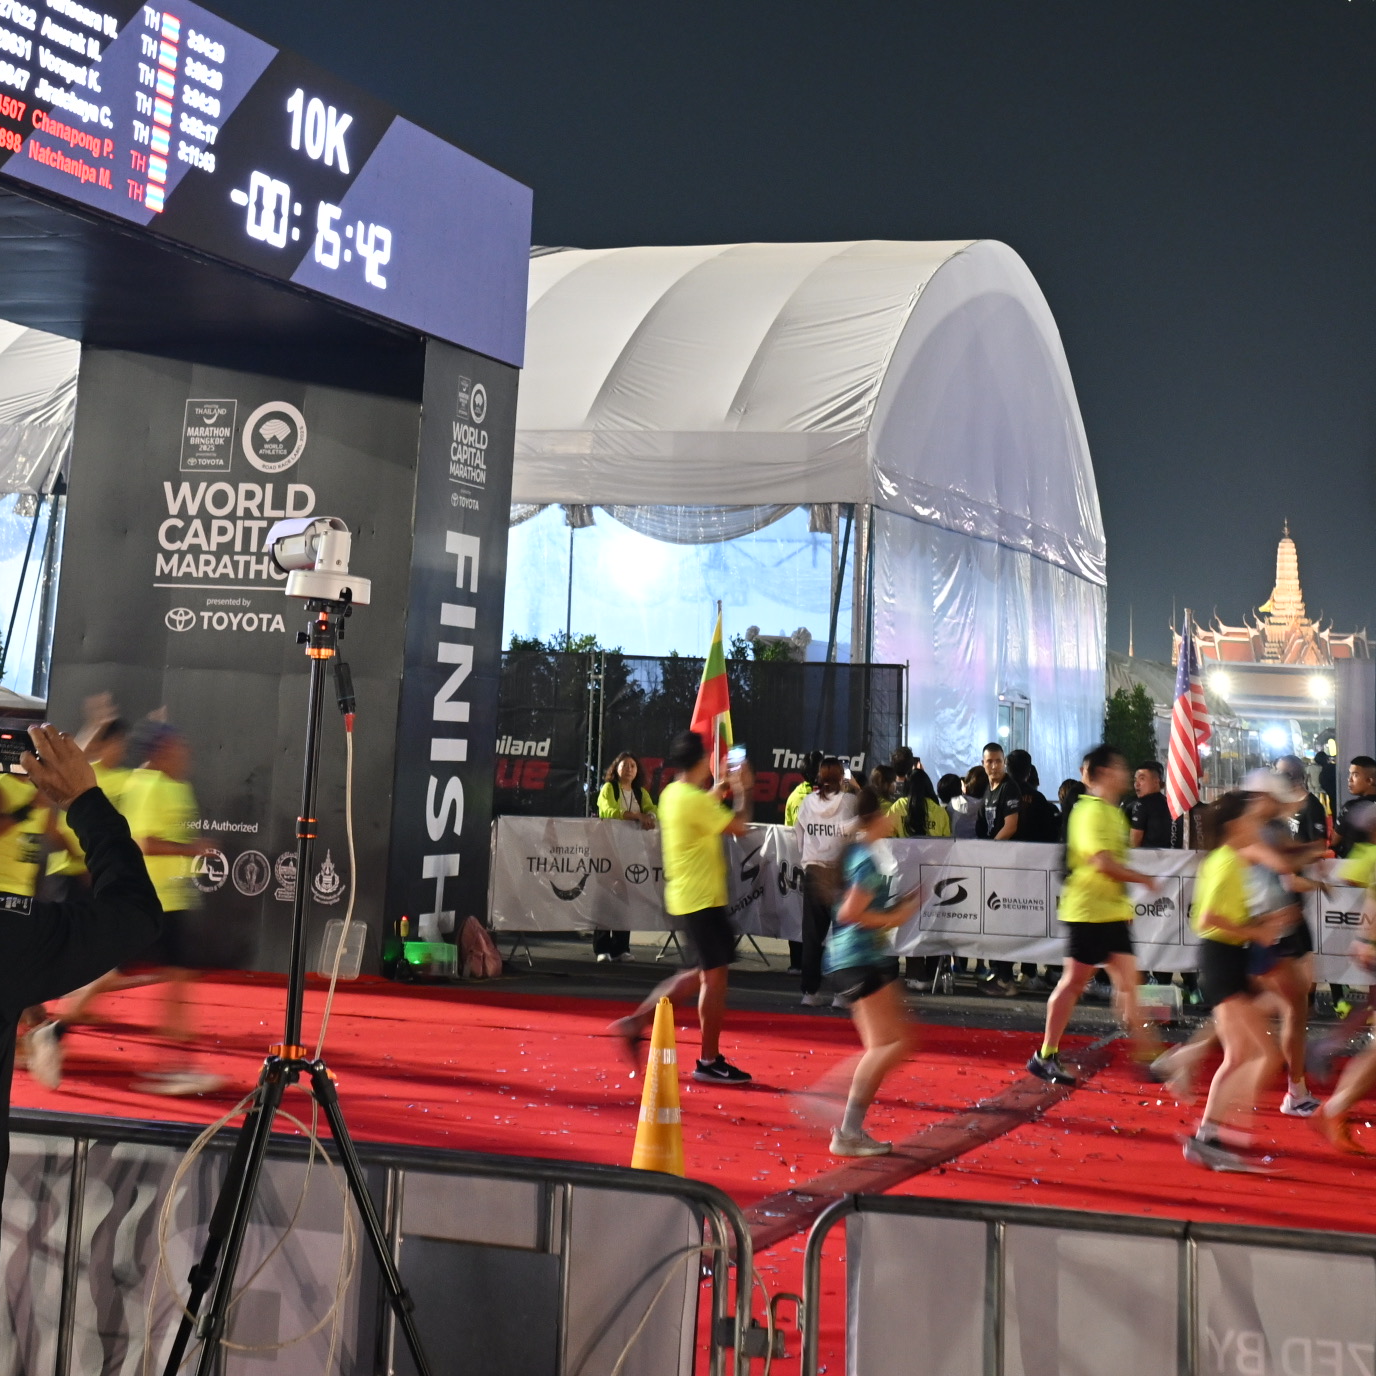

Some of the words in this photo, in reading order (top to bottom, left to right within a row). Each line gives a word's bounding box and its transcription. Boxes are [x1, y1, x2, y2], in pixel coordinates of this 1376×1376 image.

[143, 5, 160, 32] TH
[140, 33, 158, 60] TH
[138, 62, 156, 88] TH
[135, 90, 153, 117] TH
[31, 109, 102, 158] Chanapong
[102, 138, 114, 159] P.
[130, 149, 147, 172] TH
[132, 119, 150, 145] TH
[286, 87, 353, 175] 10K
[29, 139, 98, 184] Natchanipa
[98, 167, 113, 190] M.
[127, 178, 144, 202] TH
[195, 408, 227, 416] THAILAND
[186, 426, 231, 438] MARATHON
[190, 437, 225, 445] BANGKOK
[452, 420, 489, 450] WORLD
[198, 444, 215, 452] 2025
[450, 442, 487, 469] CAPITAL
[449, 461, 486, 485] MARATHON
[163, 481, 316, 518] WORLD
[459, 495, 480, 511] TOYOTA
[206, 597, 241, 607] presented
[241, 597, 252, 608] by
[200, 611, 286, 633] TOYOTA
[418, 530, 481, 938] FINISH
[202, 821, 210, 829] &
[211, 822, 258, 833] Authorized
[549, 843, 590, 857] amazing
[526, 856, 612, 874] THAILAND
[1002, 897, 1044, 905] BUALUANG
[923, 911, 978, 920] SUPERSPORTS
